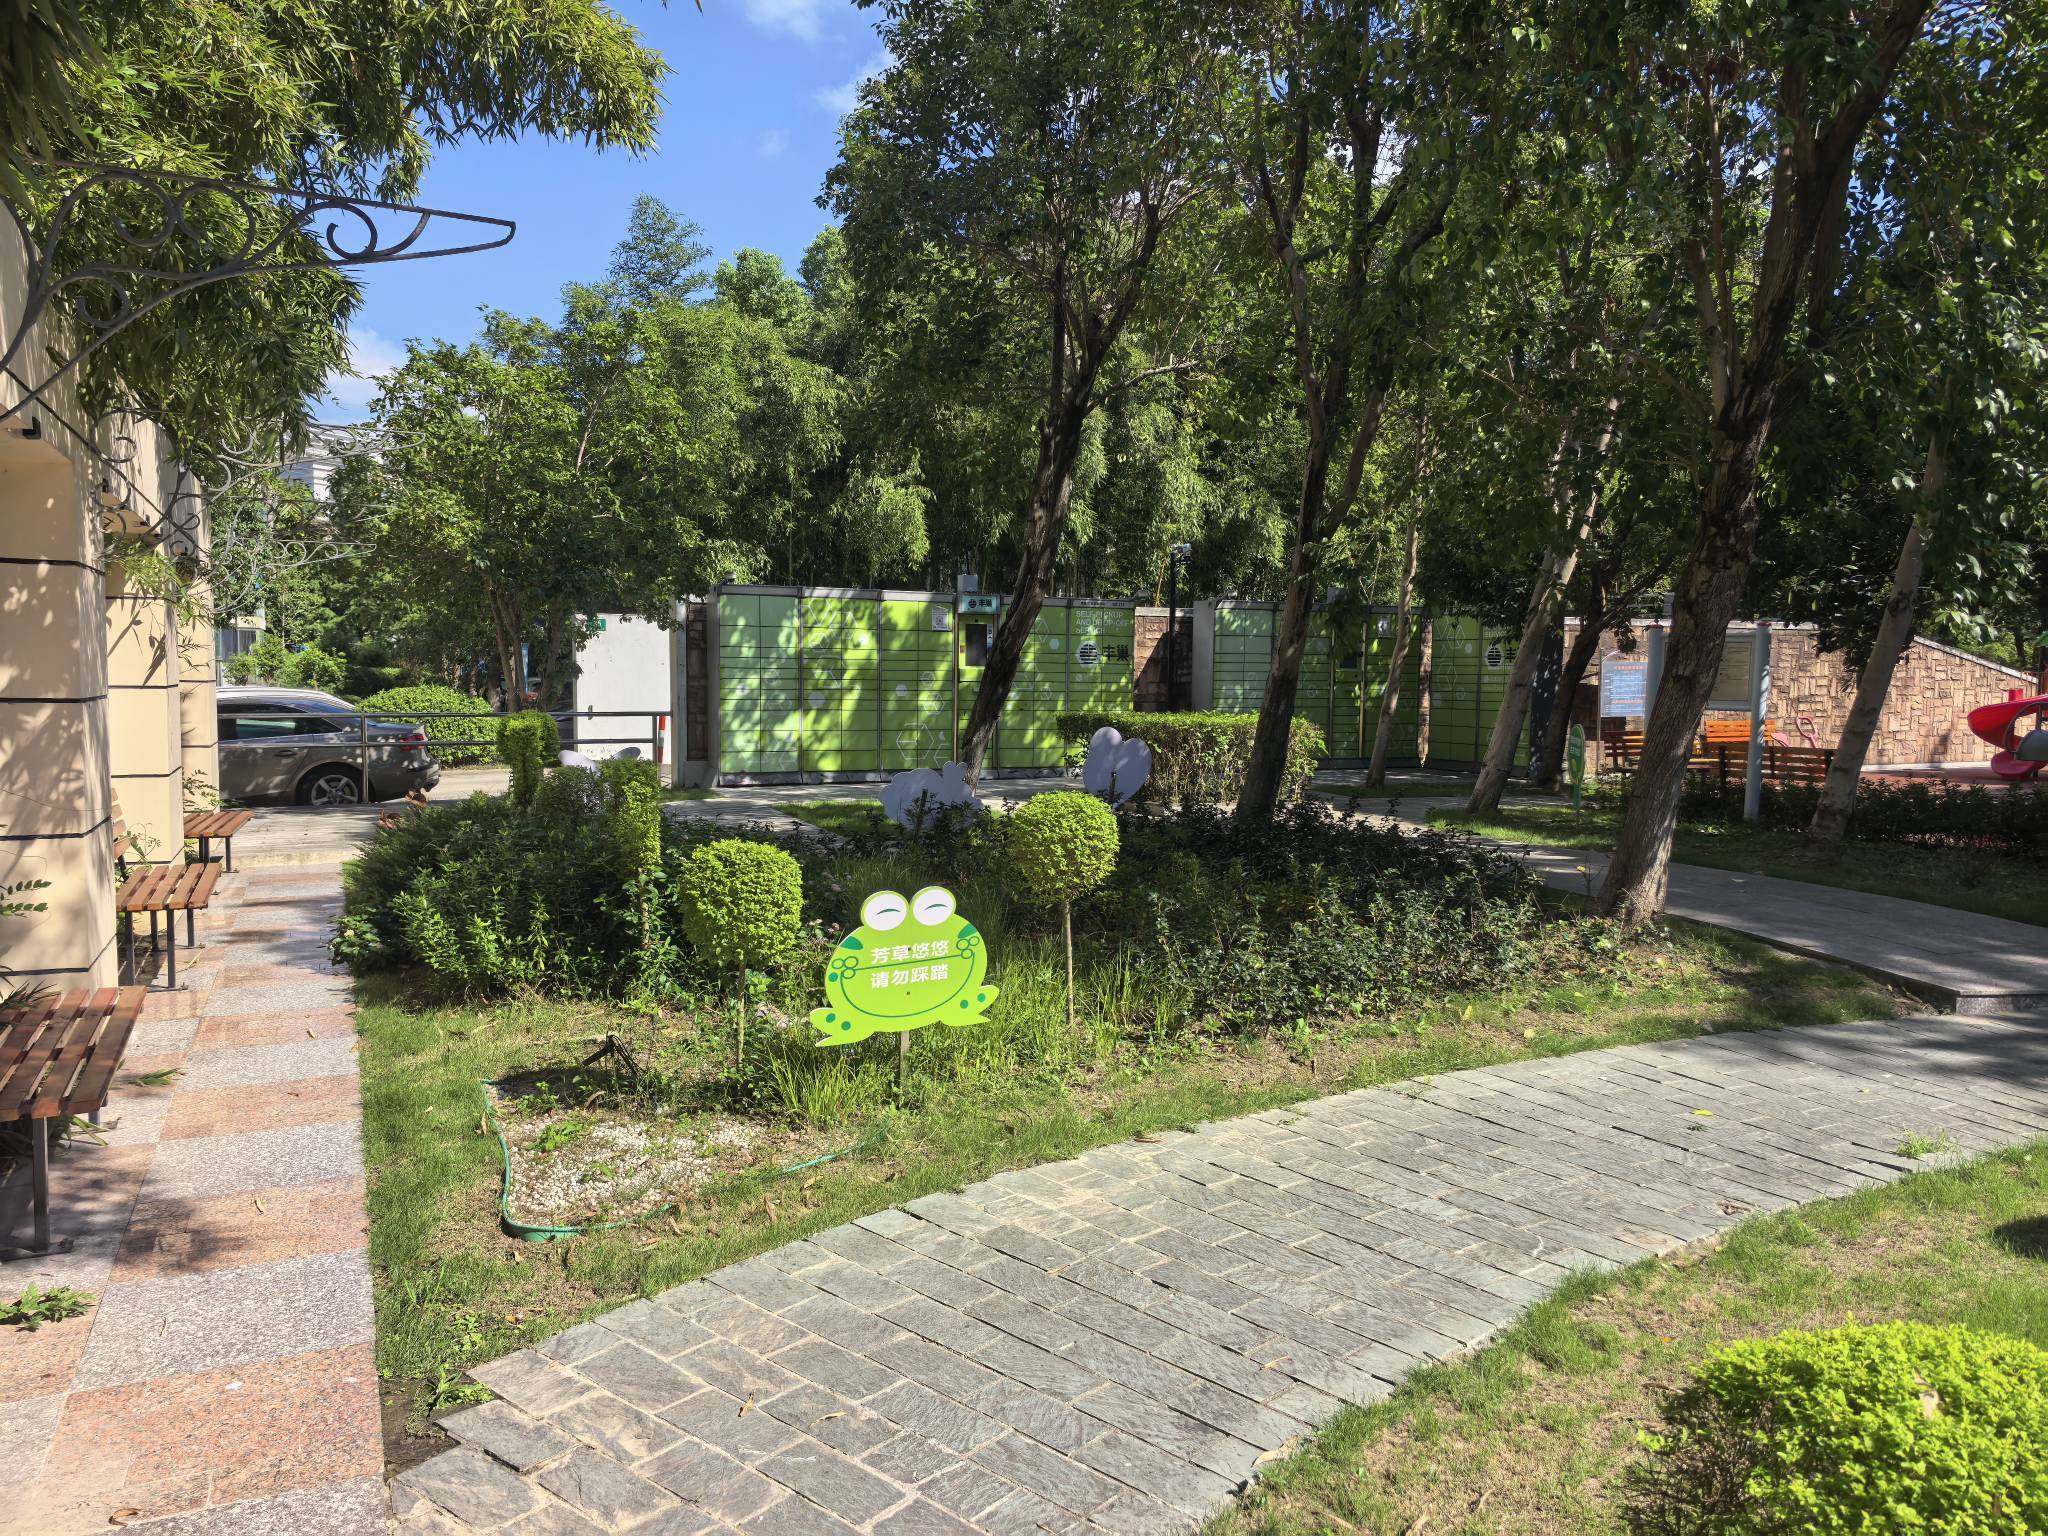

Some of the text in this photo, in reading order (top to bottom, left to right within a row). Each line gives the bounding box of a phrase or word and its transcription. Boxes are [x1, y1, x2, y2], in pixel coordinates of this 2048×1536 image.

[1103, 644, 1128, 661] 丰巢
[871, 940, 949, 965] 芳草悠悠
[870, 964, 949, 989] 请勿踩踏
